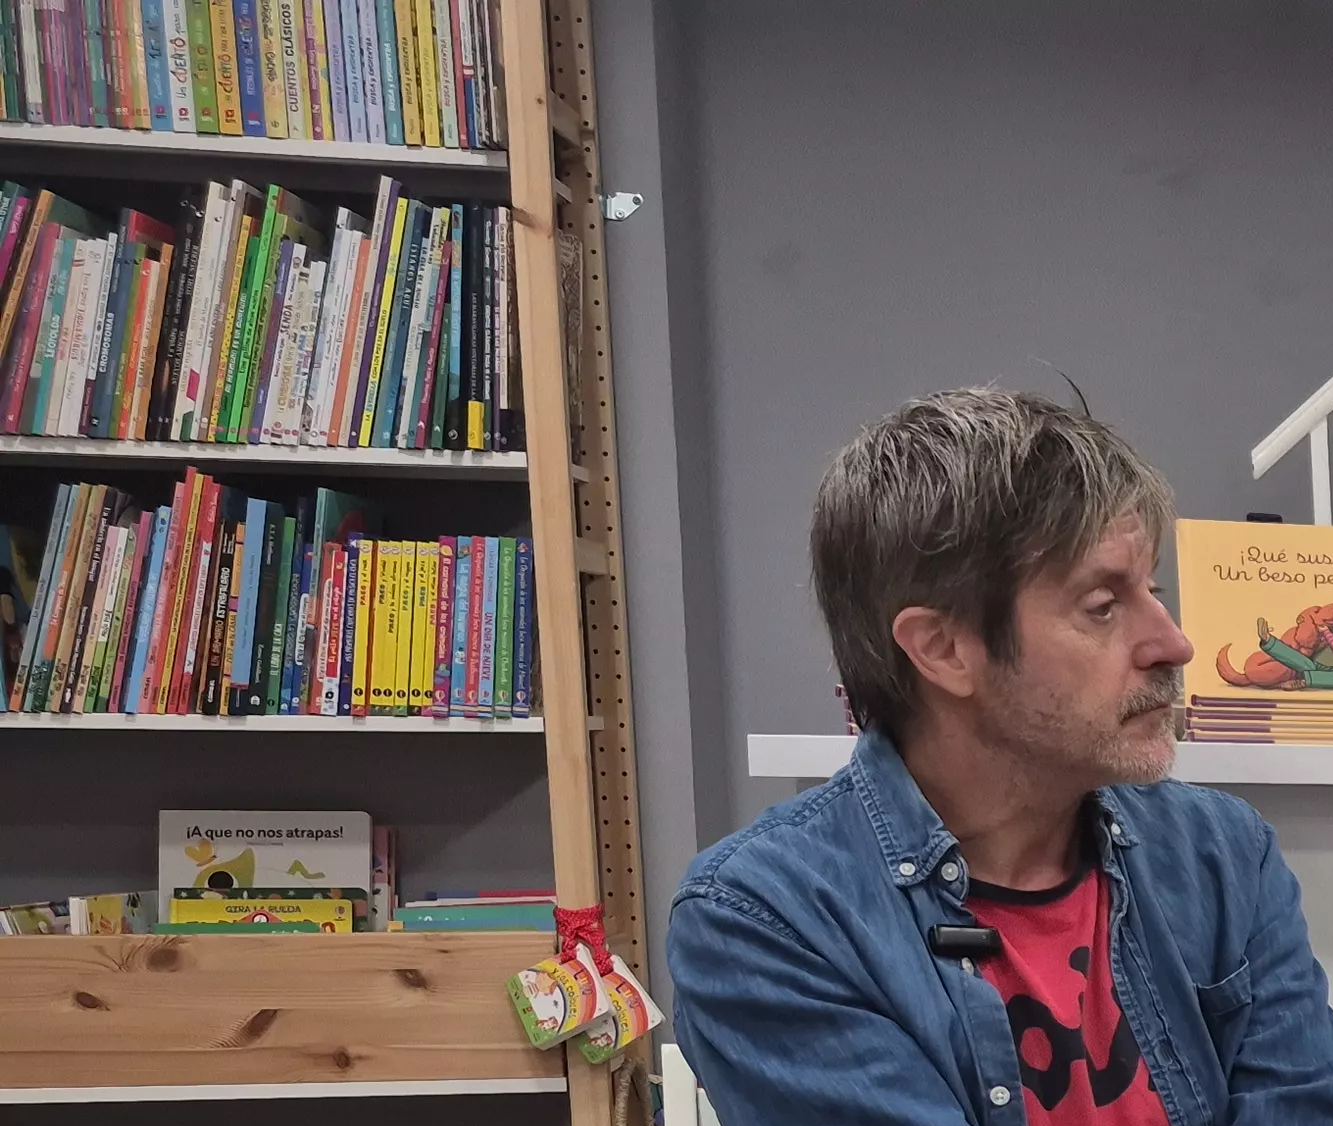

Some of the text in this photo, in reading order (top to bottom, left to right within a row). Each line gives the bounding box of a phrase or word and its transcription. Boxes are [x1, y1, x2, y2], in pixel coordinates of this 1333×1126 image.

[281, 3, 298, 112] CUENTOS CLÁSICOS
[366, 37, 375, 76] ENCUENTRA
[370, 84, 378, 105] BUSCA
[99, 312, 114, 372] CROMOSOMAS
[1239, 546, 1288, 566] ¡Qué
[1213, 564, 1252, 582] Un
[1258, 567, 1306, 584] beso
[212, 620, 224, 653] ARMARIO
[206, 828, 232, 841] que
[236, 829, 254, 838] no
[258, 829, 282, 838] nos
[286, 826, 344, 841] atrapas!
